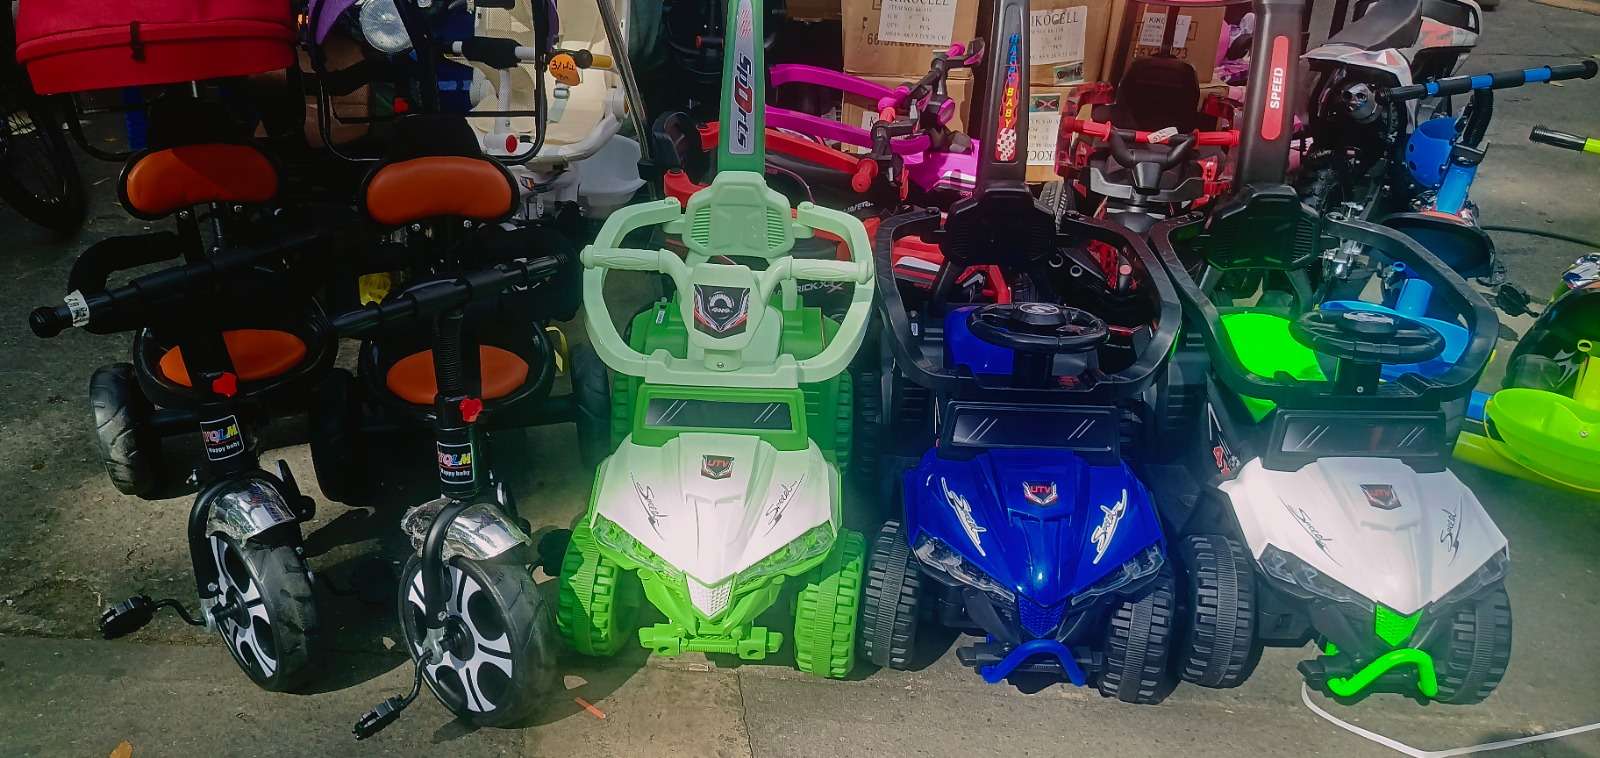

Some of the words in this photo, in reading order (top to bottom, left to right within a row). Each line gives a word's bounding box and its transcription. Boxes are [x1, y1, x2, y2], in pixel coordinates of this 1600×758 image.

[1031, 11, 1079, 27] IKOCELL
[1269, 67, 1284, 109] SPEED
[1005, 87, 1015, 128] BABY
[706, 459, 731, 468] UTV
[1030, 485, 1052, 494] UTV
